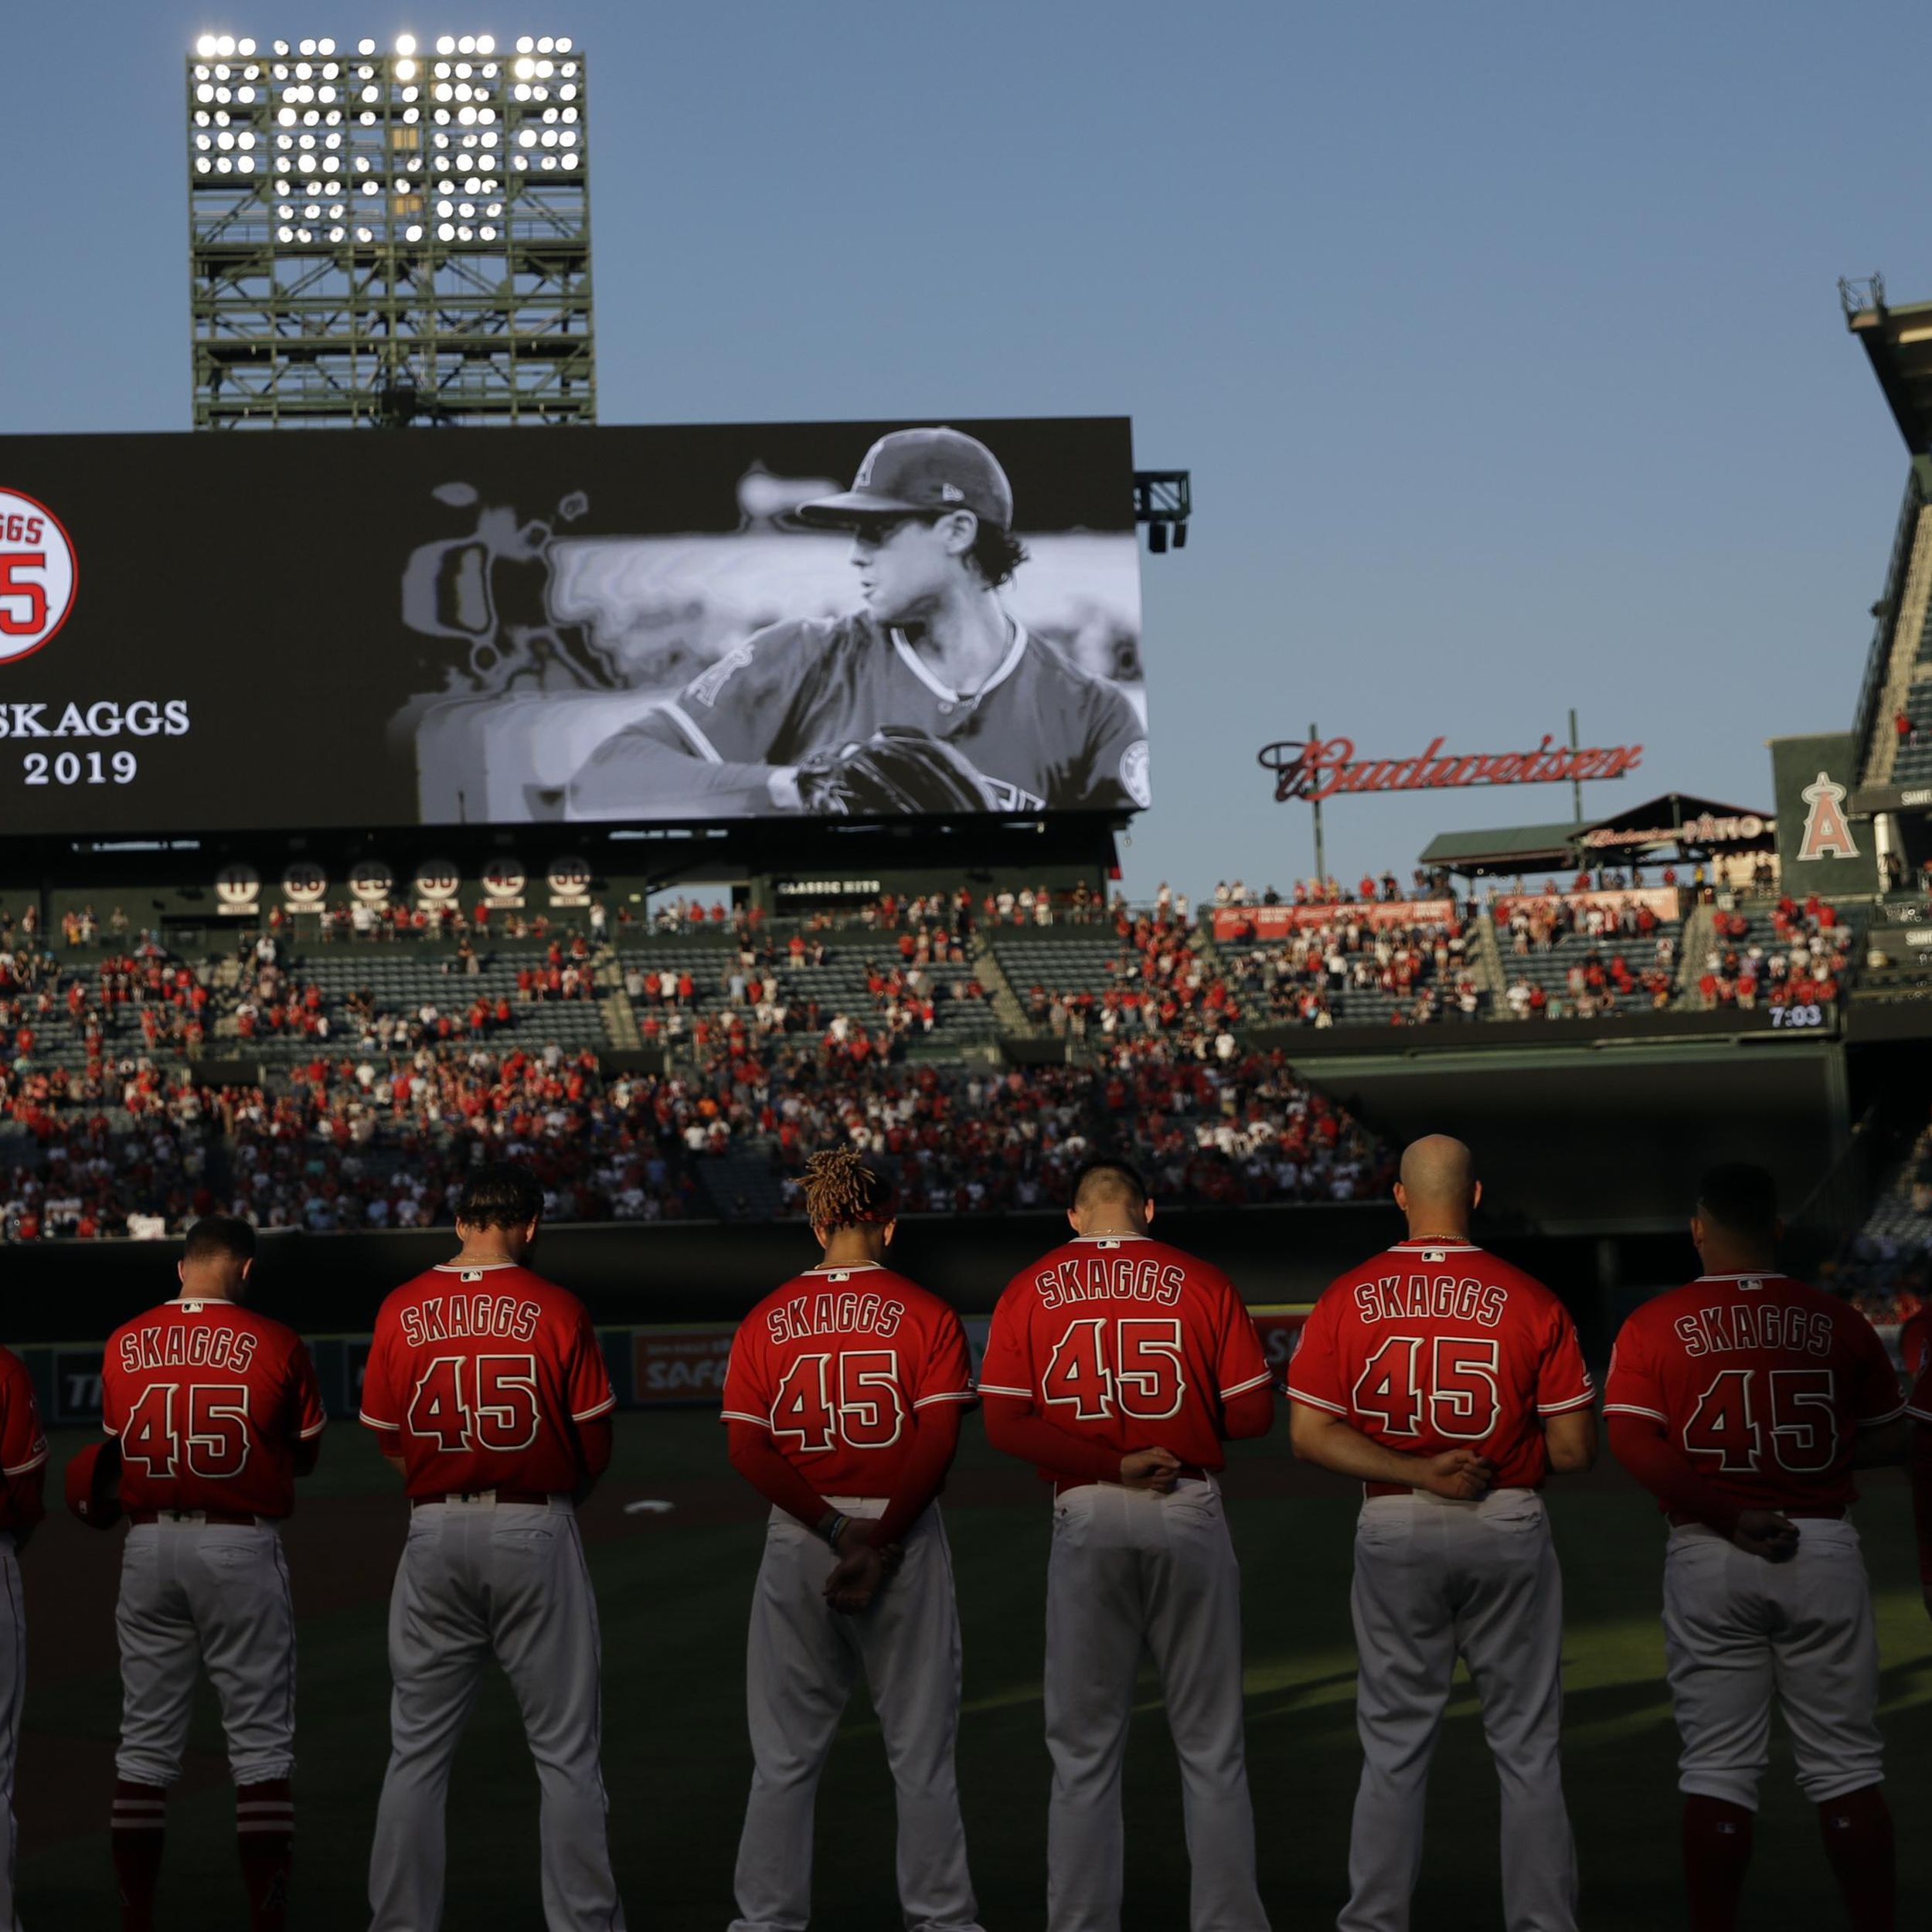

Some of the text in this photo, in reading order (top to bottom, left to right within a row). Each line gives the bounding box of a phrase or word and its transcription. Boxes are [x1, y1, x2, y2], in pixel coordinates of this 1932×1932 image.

[0, 513, 45, 546] GGS
[23, 750, 138, 784] 2019
[1258, 734, 1644, 802] Budweiser
[1682, 812, 1764, 844] PATIO
[1769, 1005, 1822, 1028] 7:03
[1036, 1258, 1185, 1311] SKAGGS
[1353, 1274, 1509, 1328] SKAGGS
[400, 1294, 542, 1348] SKAGGS
[767, 1292, 906, 1345] SKAGGS
[1674, 1304, 1834, 1358] SKAGGS
[119, 1325, 258, 1374] SKAGGS
[1041, 1318, 1187, 1420] 45
[406, 1354, 542, 1452] 45
[770, 1349, 905, 1453] 45
[1352, 1335, 1502, 1440] 45
[121, 1383, 252, 1478] 45
[1682, 1369, 1838, 1472] 45
